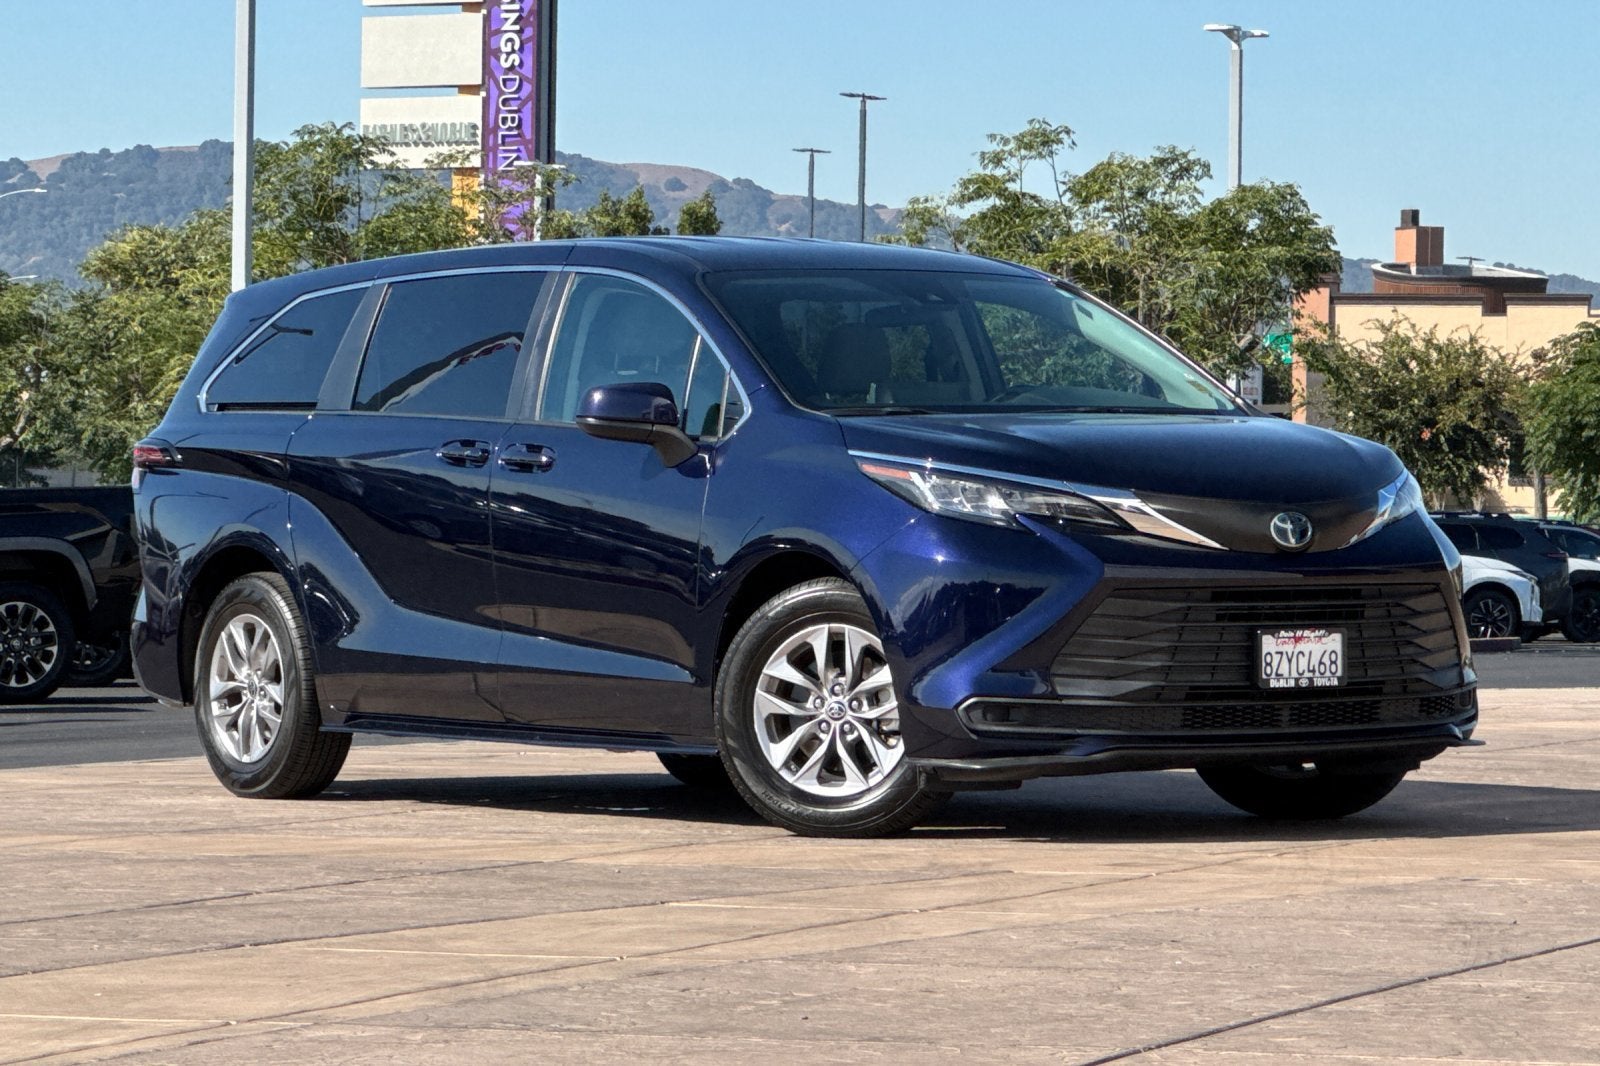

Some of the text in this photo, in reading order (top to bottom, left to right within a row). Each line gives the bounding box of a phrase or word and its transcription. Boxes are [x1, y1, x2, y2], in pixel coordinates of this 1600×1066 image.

[498, 0, 520, 171] INGS DUBLIN
[1264, 650, 1338, 677] 8ZYC468
[1270, 677, 1339, 688] DUBLIN TOYOTA
